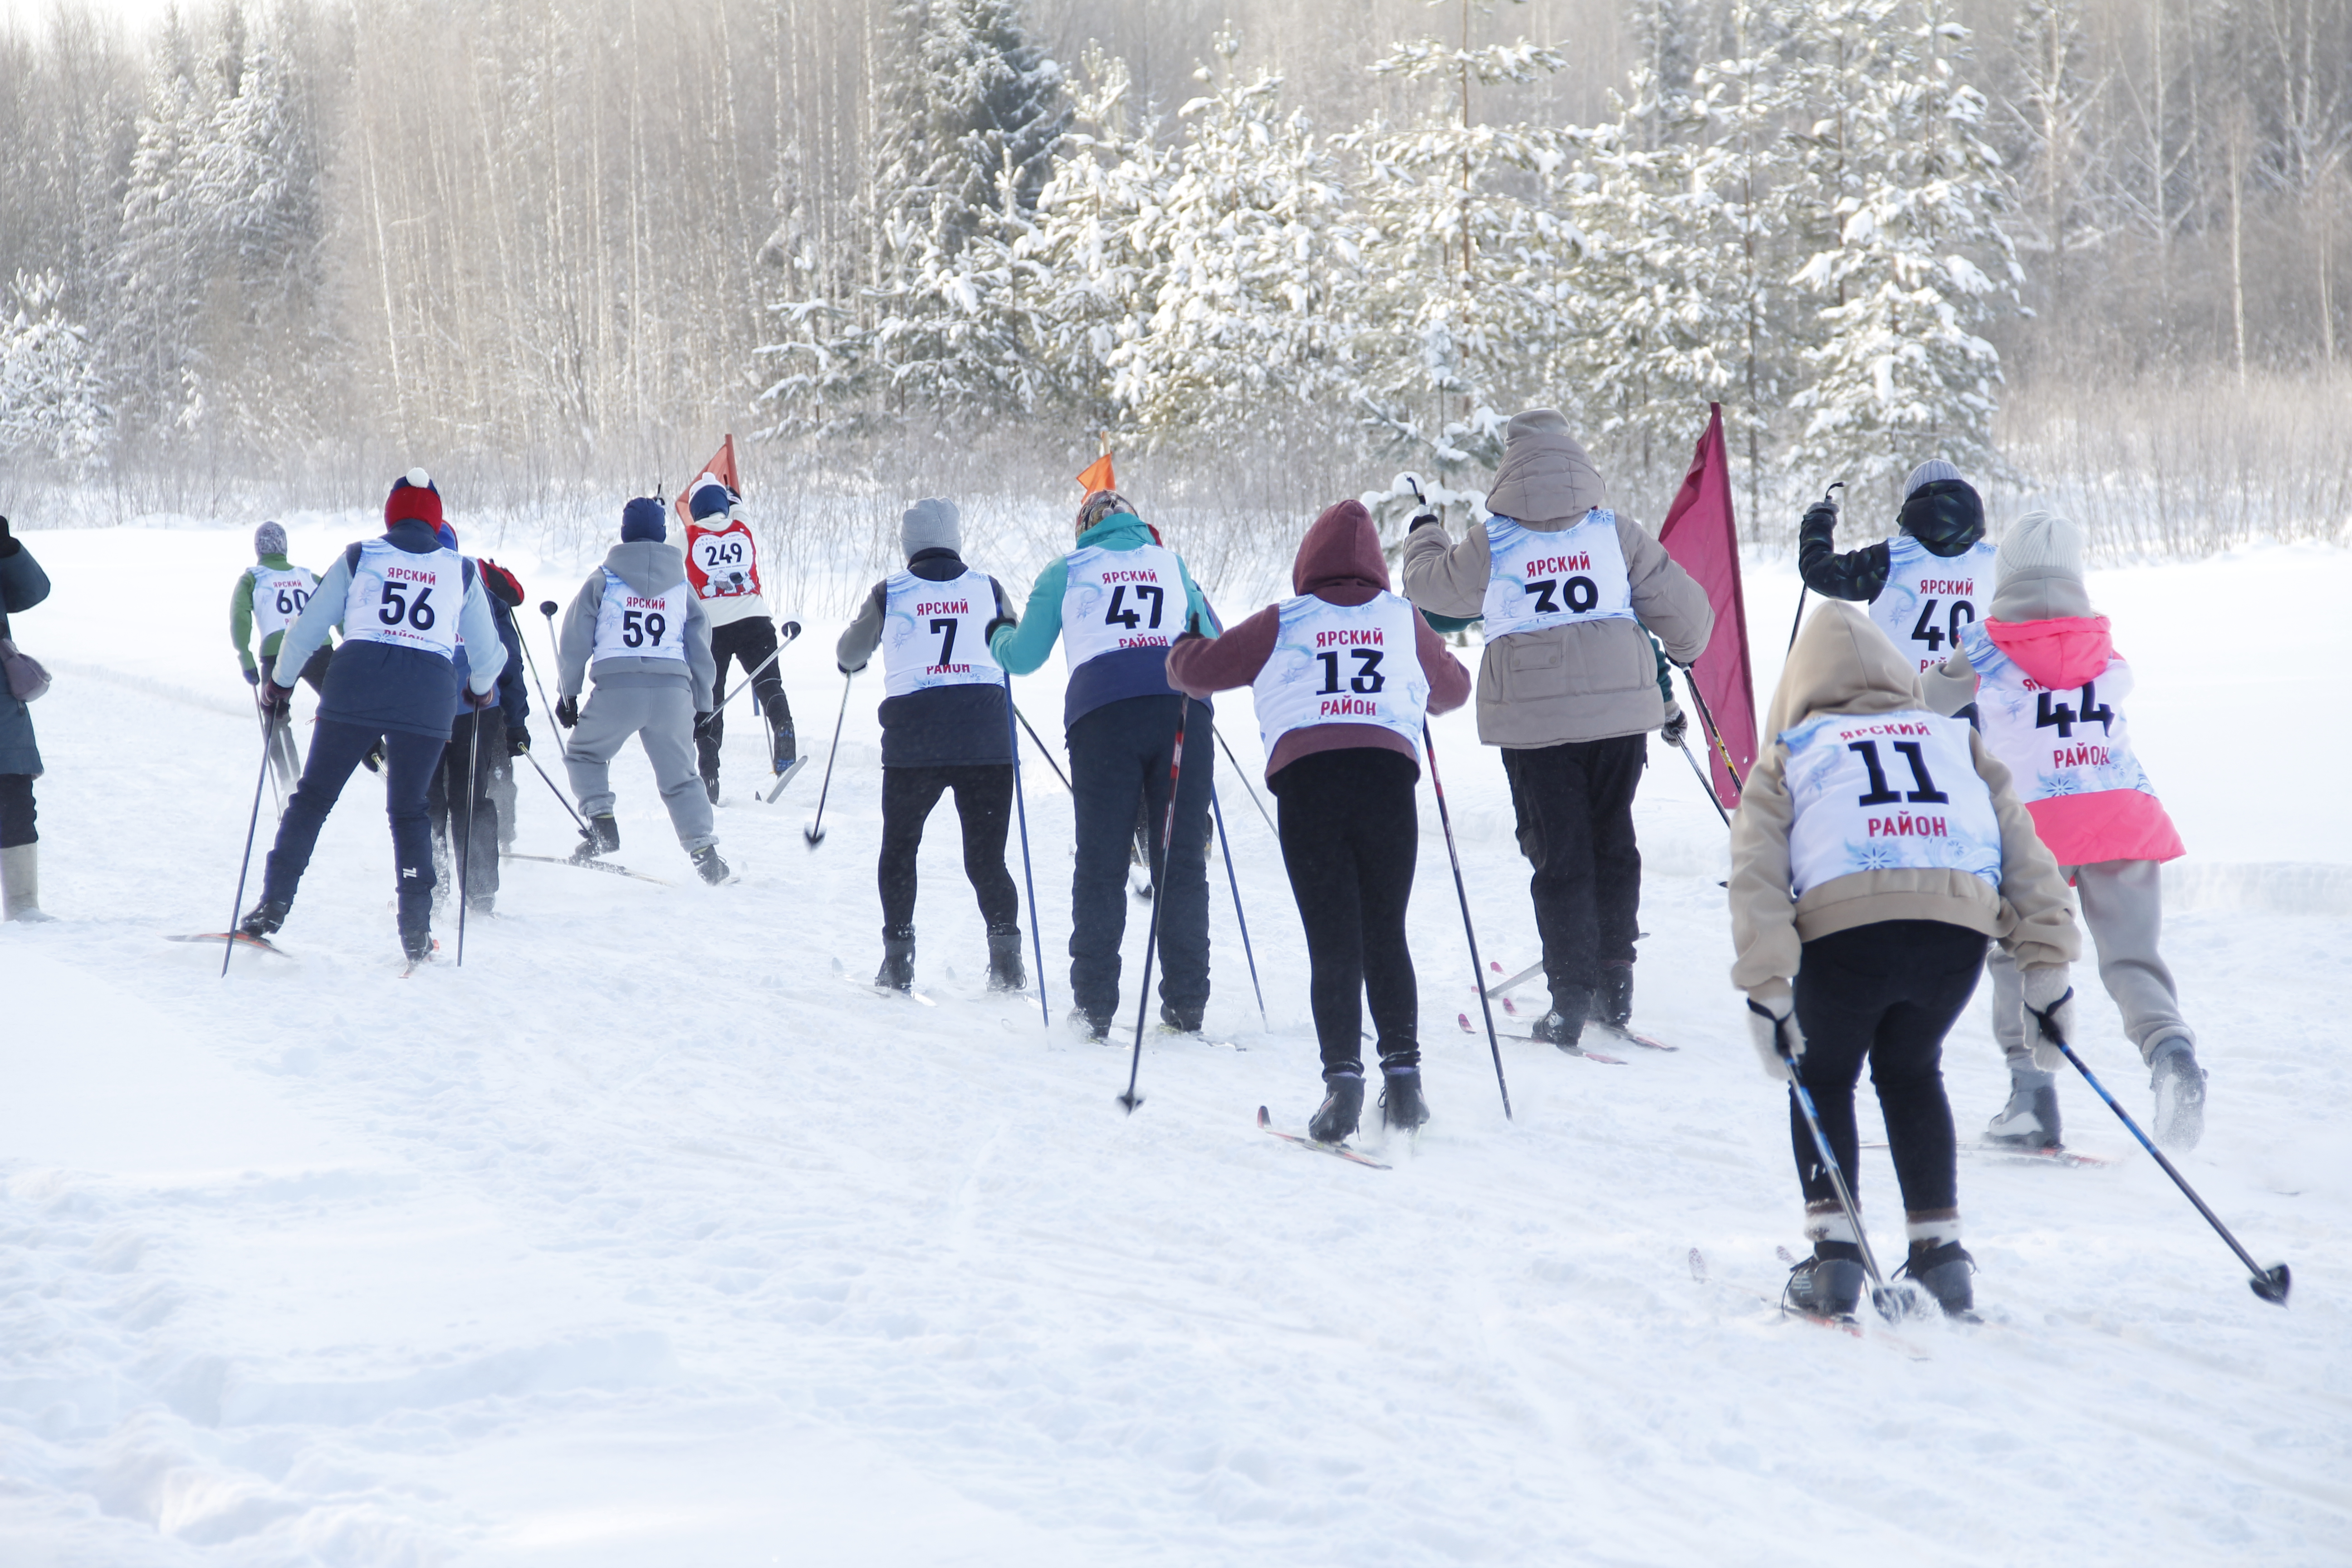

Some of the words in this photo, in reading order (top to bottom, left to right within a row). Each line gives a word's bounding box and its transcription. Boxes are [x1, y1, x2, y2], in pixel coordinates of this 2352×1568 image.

[706, 543, 742, 566] 249
[1527, 551, 1591, 578] ЯРСКИЙ
[273, 579, 302, 588] ЯРСКИЙ
[387, 567, 436, 585] ЯРСКИЙ
[1102, 568, 1158, 584] ЯРСКИЙ
[1920, 578, 1973, 596] ЯРСКИЙ
[276, 589, 309, 614] 60
[379, 581, 435, 631] 56
[626, 597, 665, 611] ЯРСКИЙ
[916, 598, 969, 616] ЯРСКИЙ
[1105, 585, 1163, 629] 47
[623, 610, 665, 648] 59
[1316, 627, 1383, 648] ЯРСКИЙ
[1911, 599, 1975, 652] 40
[930, 618, 957, 665] 7
[1119, 633, 1168, 648] РАЙОН
[1316, 648, 1385, 696] 13
[1321, 695, 1376, 715] РАЙОН
[2035, 681, 2115, 738] 44
[1840, 722, 1931, 740] ЯРСКИЙ
[2053, 742, 2110, 769] РАЙОН
[1848, 740, 1950, 807] 11
[1868, 811, 1947, 837] РАЙОН
